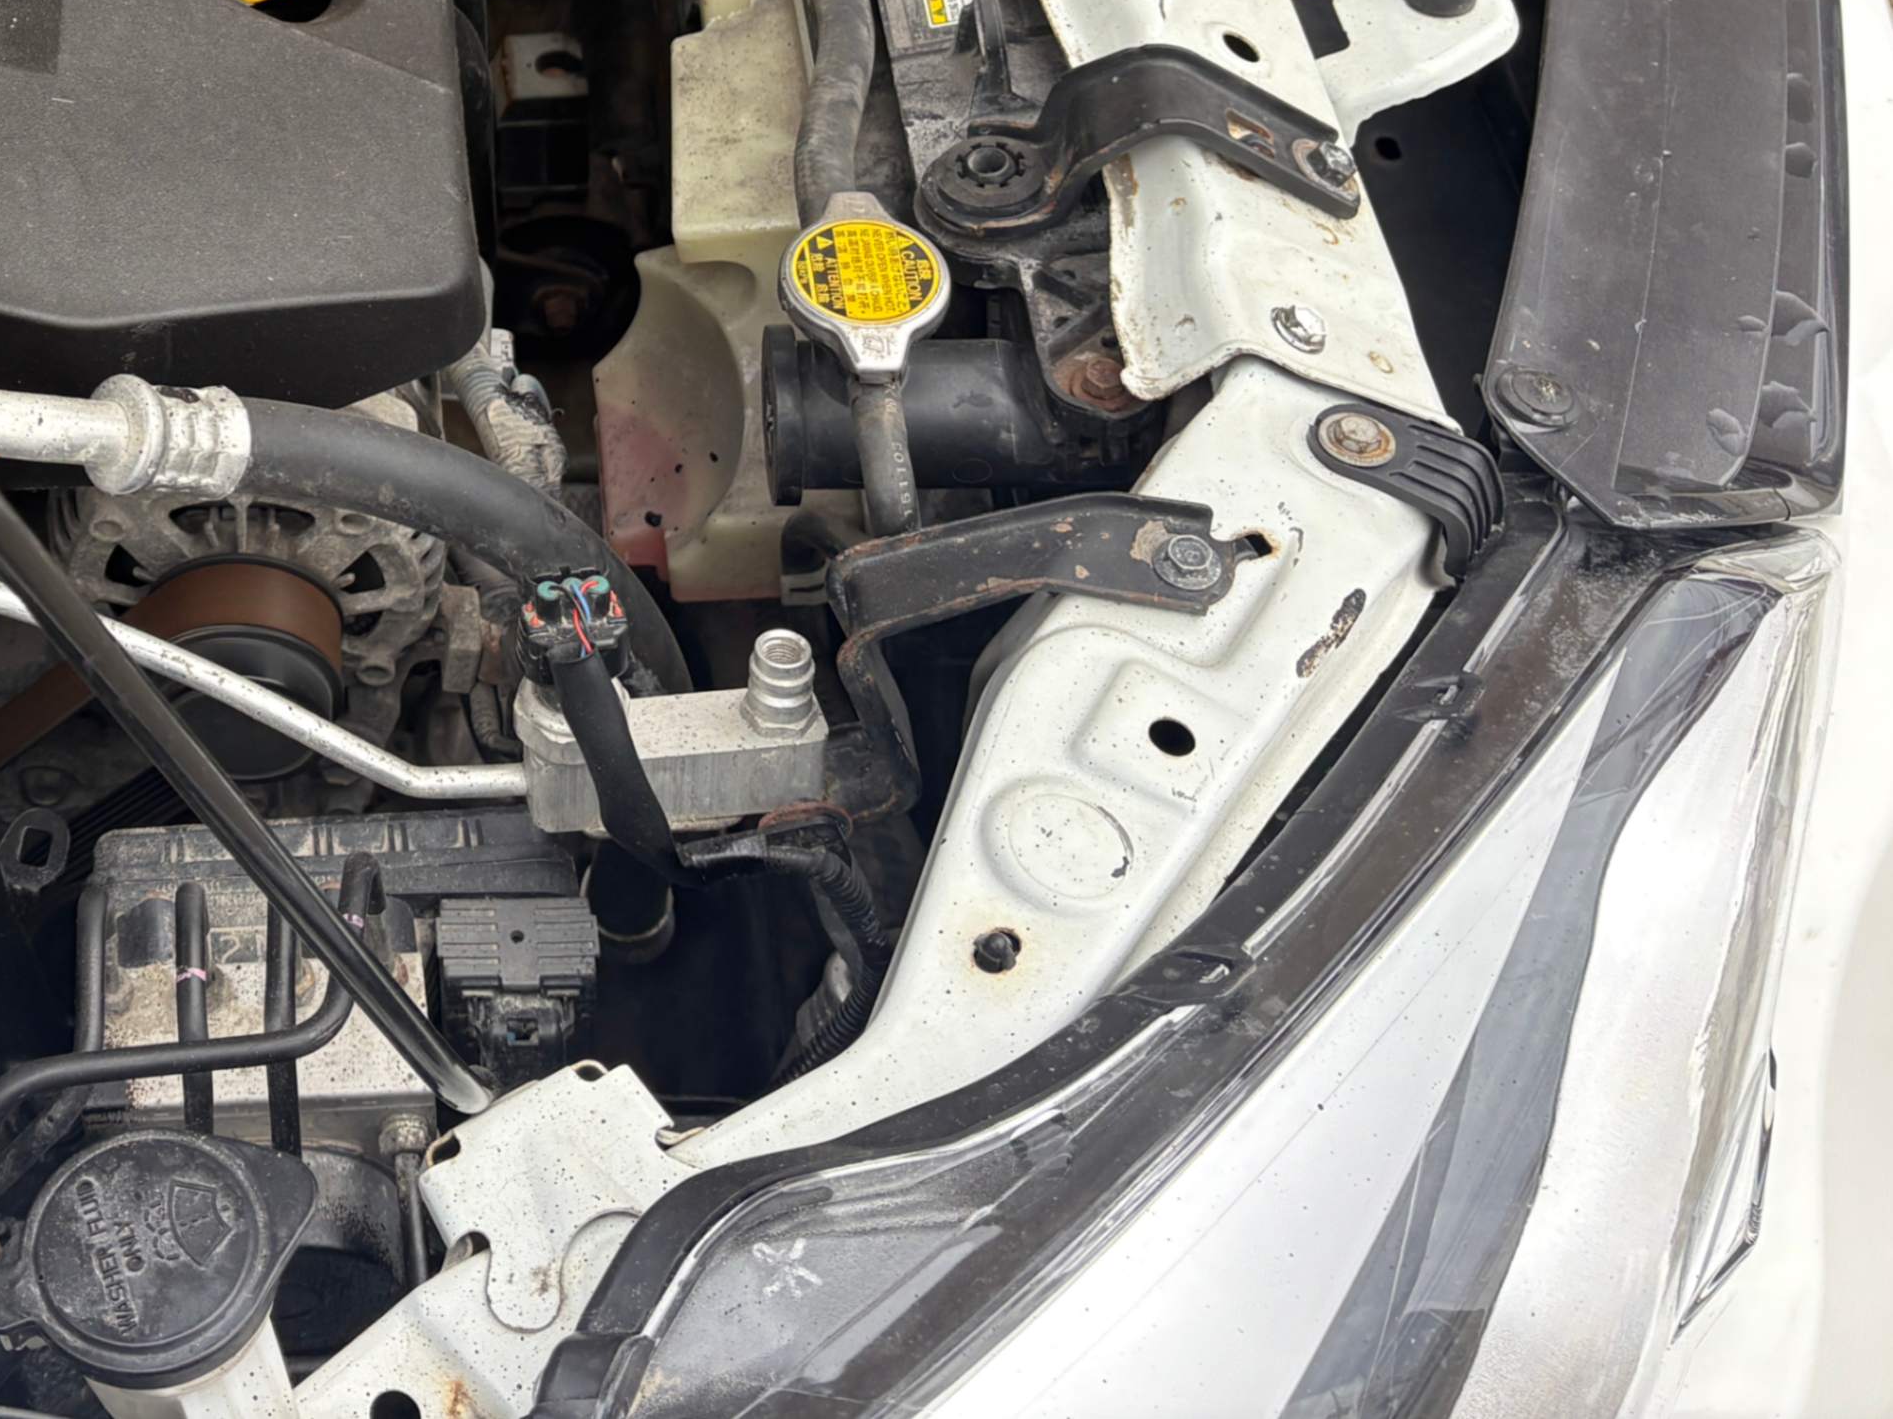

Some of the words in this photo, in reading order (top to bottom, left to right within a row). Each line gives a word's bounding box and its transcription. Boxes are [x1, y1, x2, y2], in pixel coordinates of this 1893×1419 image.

[825, 257, 844, 309] ATTENTION
[900, 250, 922, 302] CAUTION
[75, 1178, 109, 1238] FLUID
[113, 1221, 146, 1273] ONLY
[94, 1245, 140, 1337] WASHER
